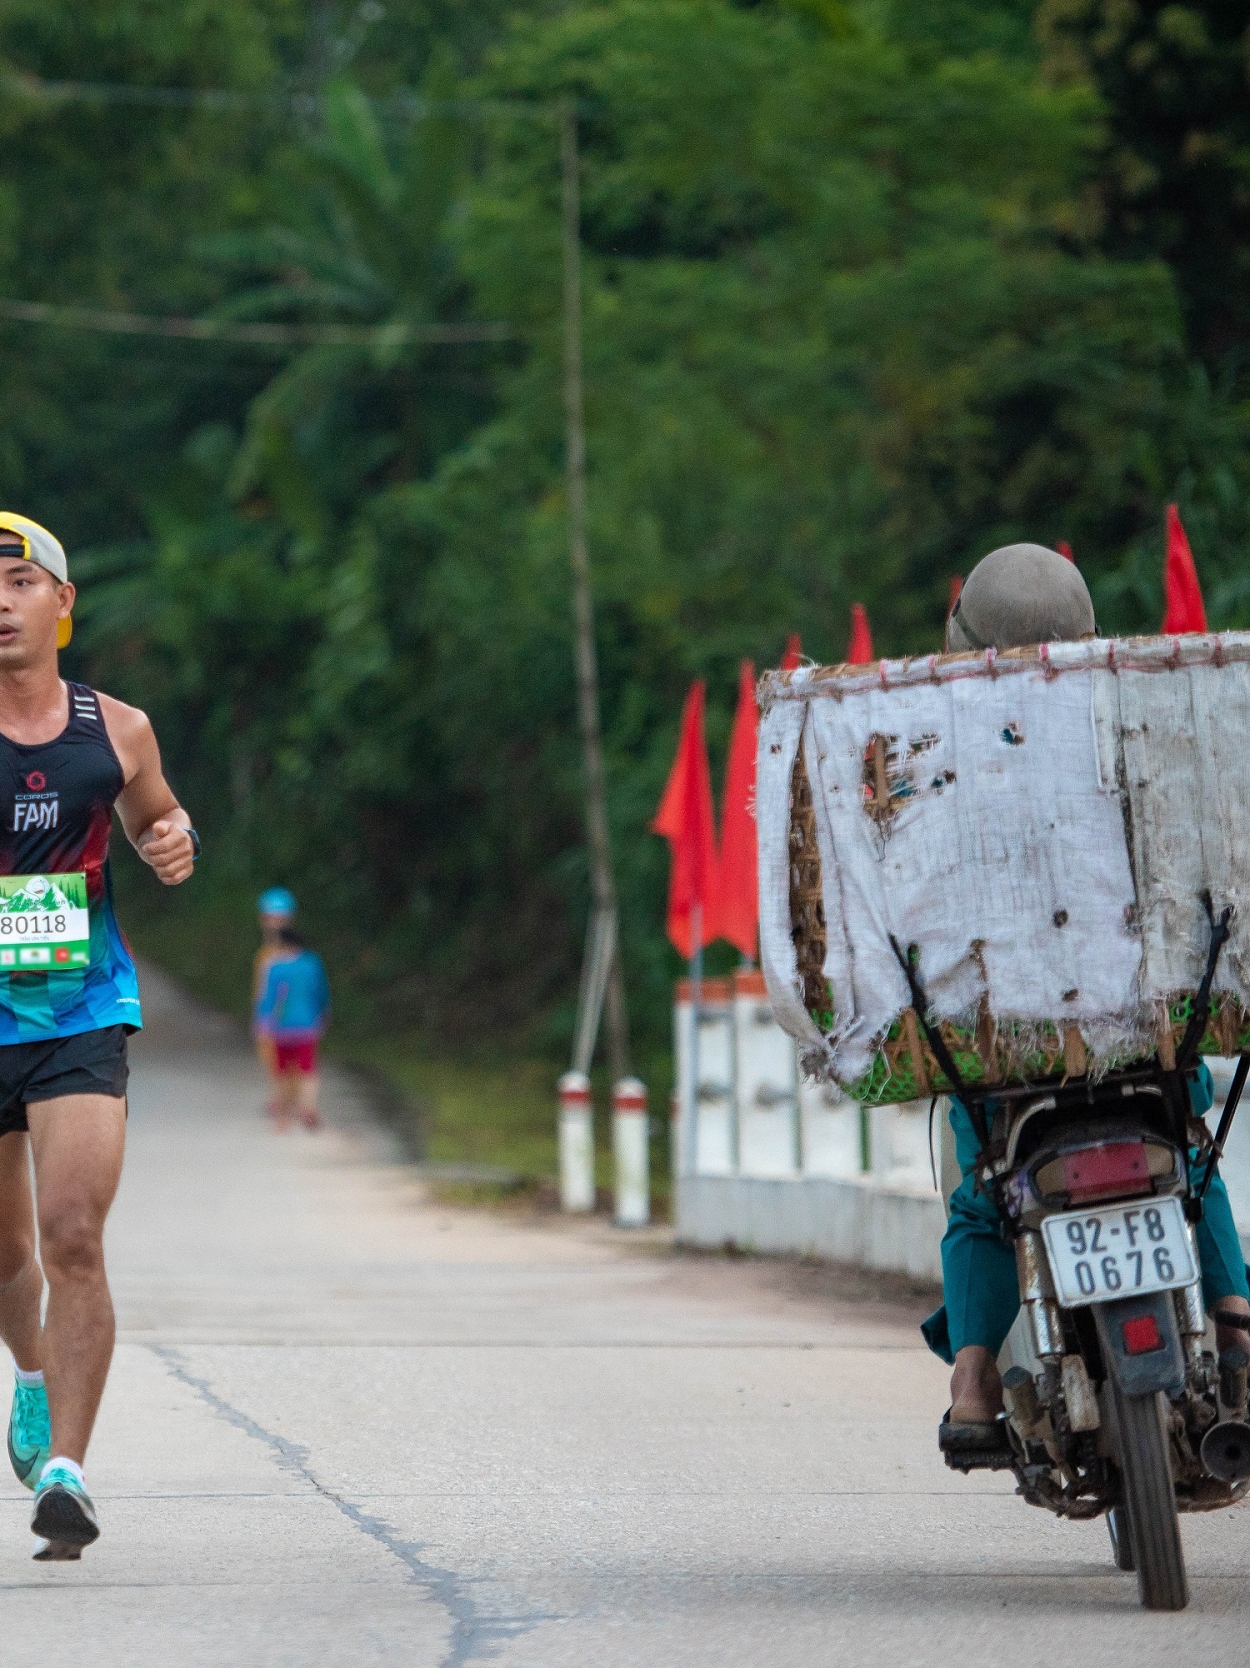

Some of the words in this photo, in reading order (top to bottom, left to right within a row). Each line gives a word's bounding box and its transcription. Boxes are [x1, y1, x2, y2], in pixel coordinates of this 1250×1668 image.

[15, 792, 58, 801] COROS
[14, 800, 59, 831] FAM
[0, 914, 67, 935] 80118
[1066, 1208, 1166, 1255] 92-F8
[1074, 1247, 1176, 1296] 0676
